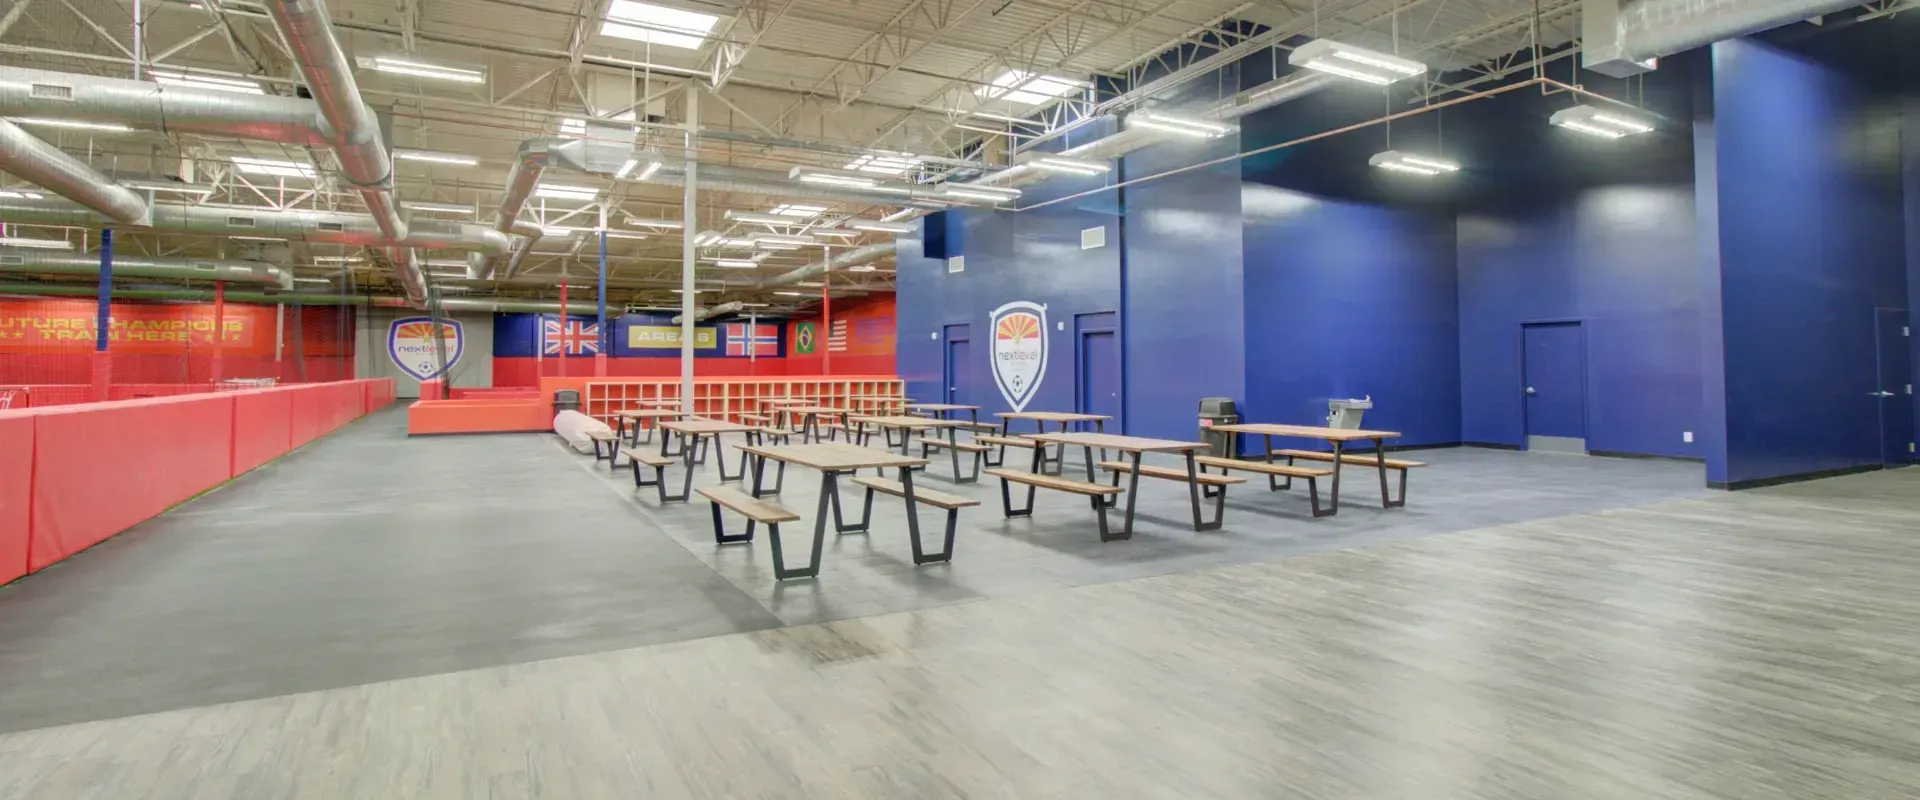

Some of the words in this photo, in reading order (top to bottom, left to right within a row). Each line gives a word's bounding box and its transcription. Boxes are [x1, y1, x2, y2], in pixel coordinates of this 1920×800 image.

[0, 317, 86, 328] UTURE
[126, 331, 189, 341] HERE
[398, 344, 454, 353] nextleel
[997, 348, 1038, 361] nextlevel
